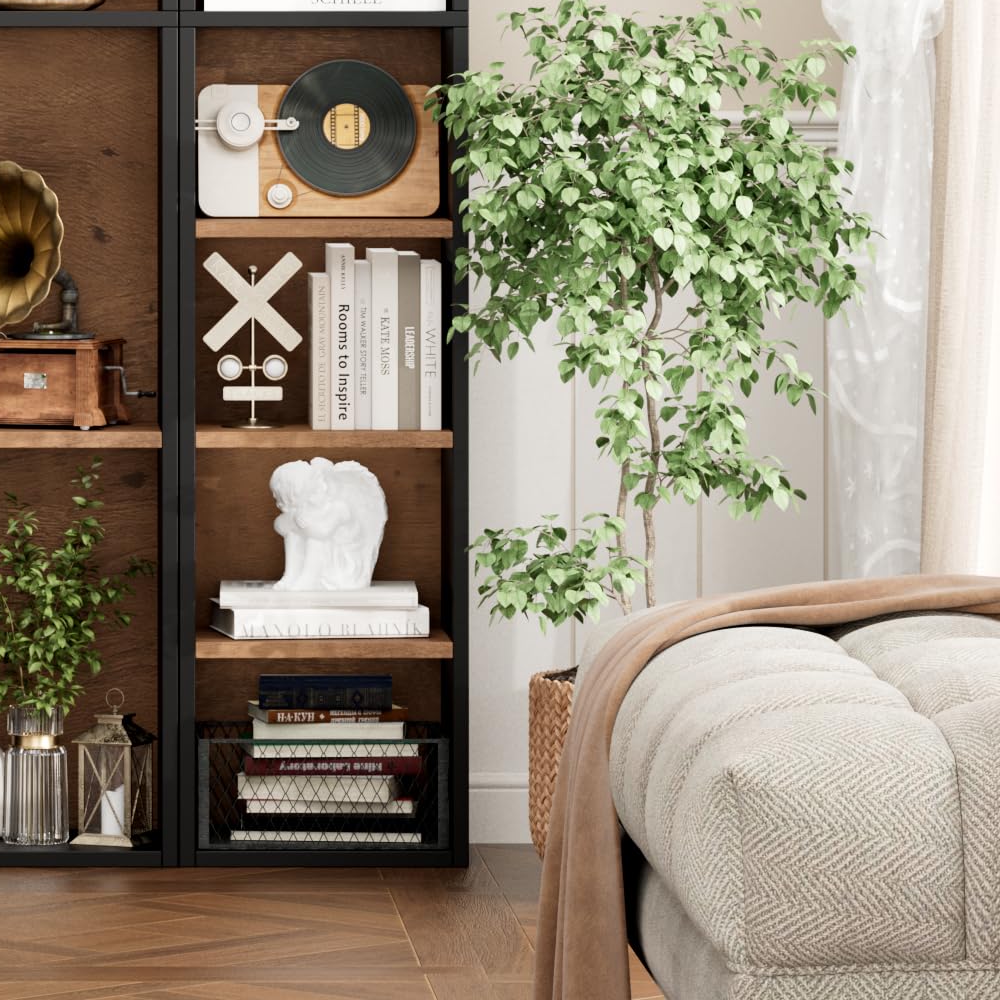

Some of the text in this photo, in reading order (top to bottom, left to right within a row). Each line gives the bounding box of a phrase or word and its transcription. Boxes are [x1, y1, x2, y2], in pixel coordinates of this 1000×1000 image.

[336, 304, 350, 421] Rooms to Inspire
[380, 317, 390, 376] KATE MOSS
[404, 326, 415, 369] LEADERSHIP
[424, 327, 437, 377] WHITE
[240, 623, 332, 638] MANOLO
